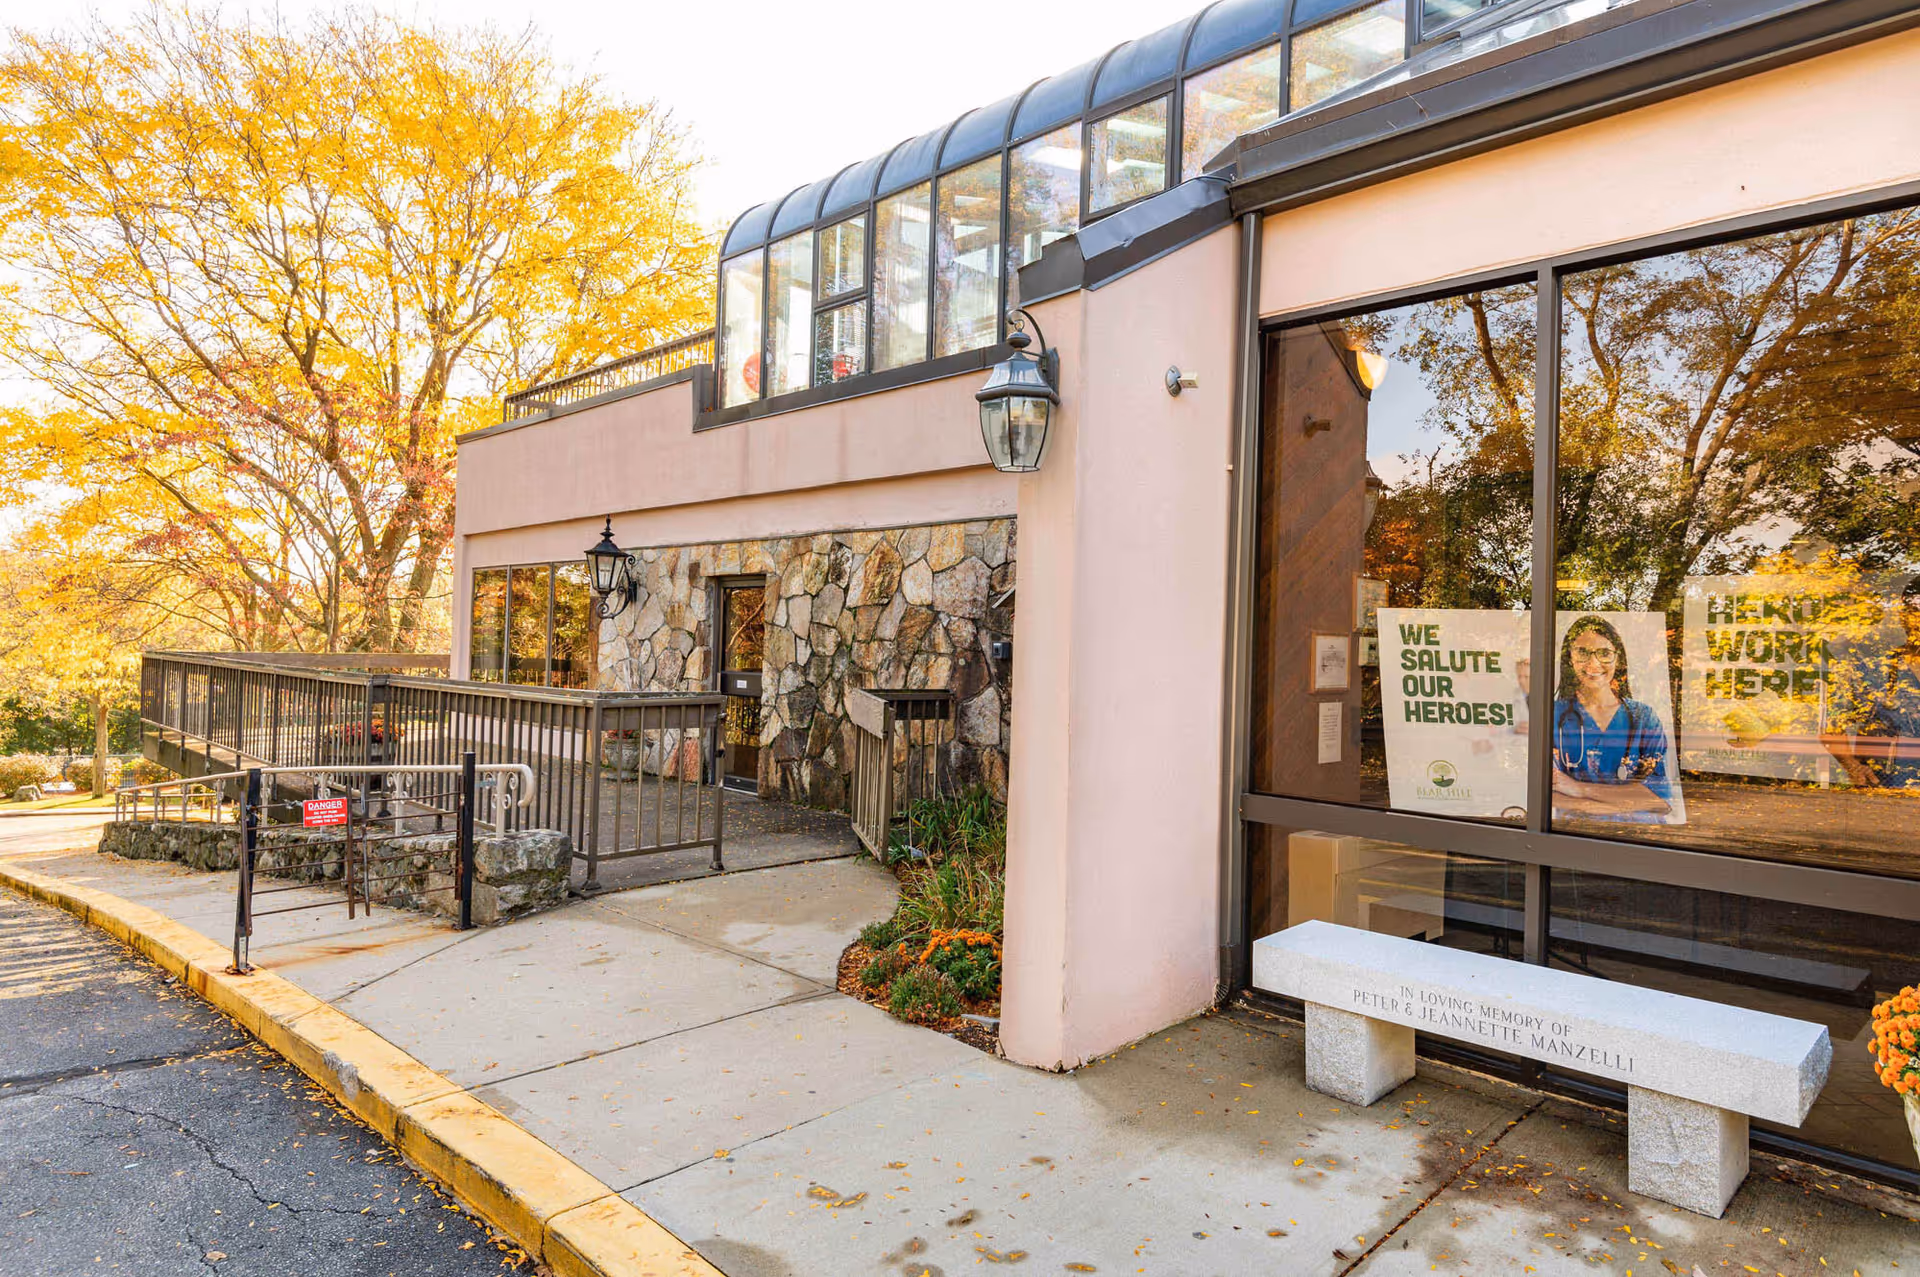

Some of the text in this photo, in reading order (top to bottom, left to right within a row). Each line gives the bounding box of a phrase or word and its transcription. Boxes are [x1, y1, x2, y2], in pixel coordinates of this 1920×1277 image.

[1399, 623, 1440, 646] WE
[1401, 649, 1502, 673] SALUTE
[1402, 675, 1455, 698] OUR
[1706, 668, 1829, 700] HERE
[1404, 701, 1514, 726] HEROES!
[308, 801, 343, 811] DANGER
[1400, 986, 1573, 1037] IN LOVING MEMORY OF
[1353, 989, 1637, 1072] PETER & JEANNETTE MANZELLI
